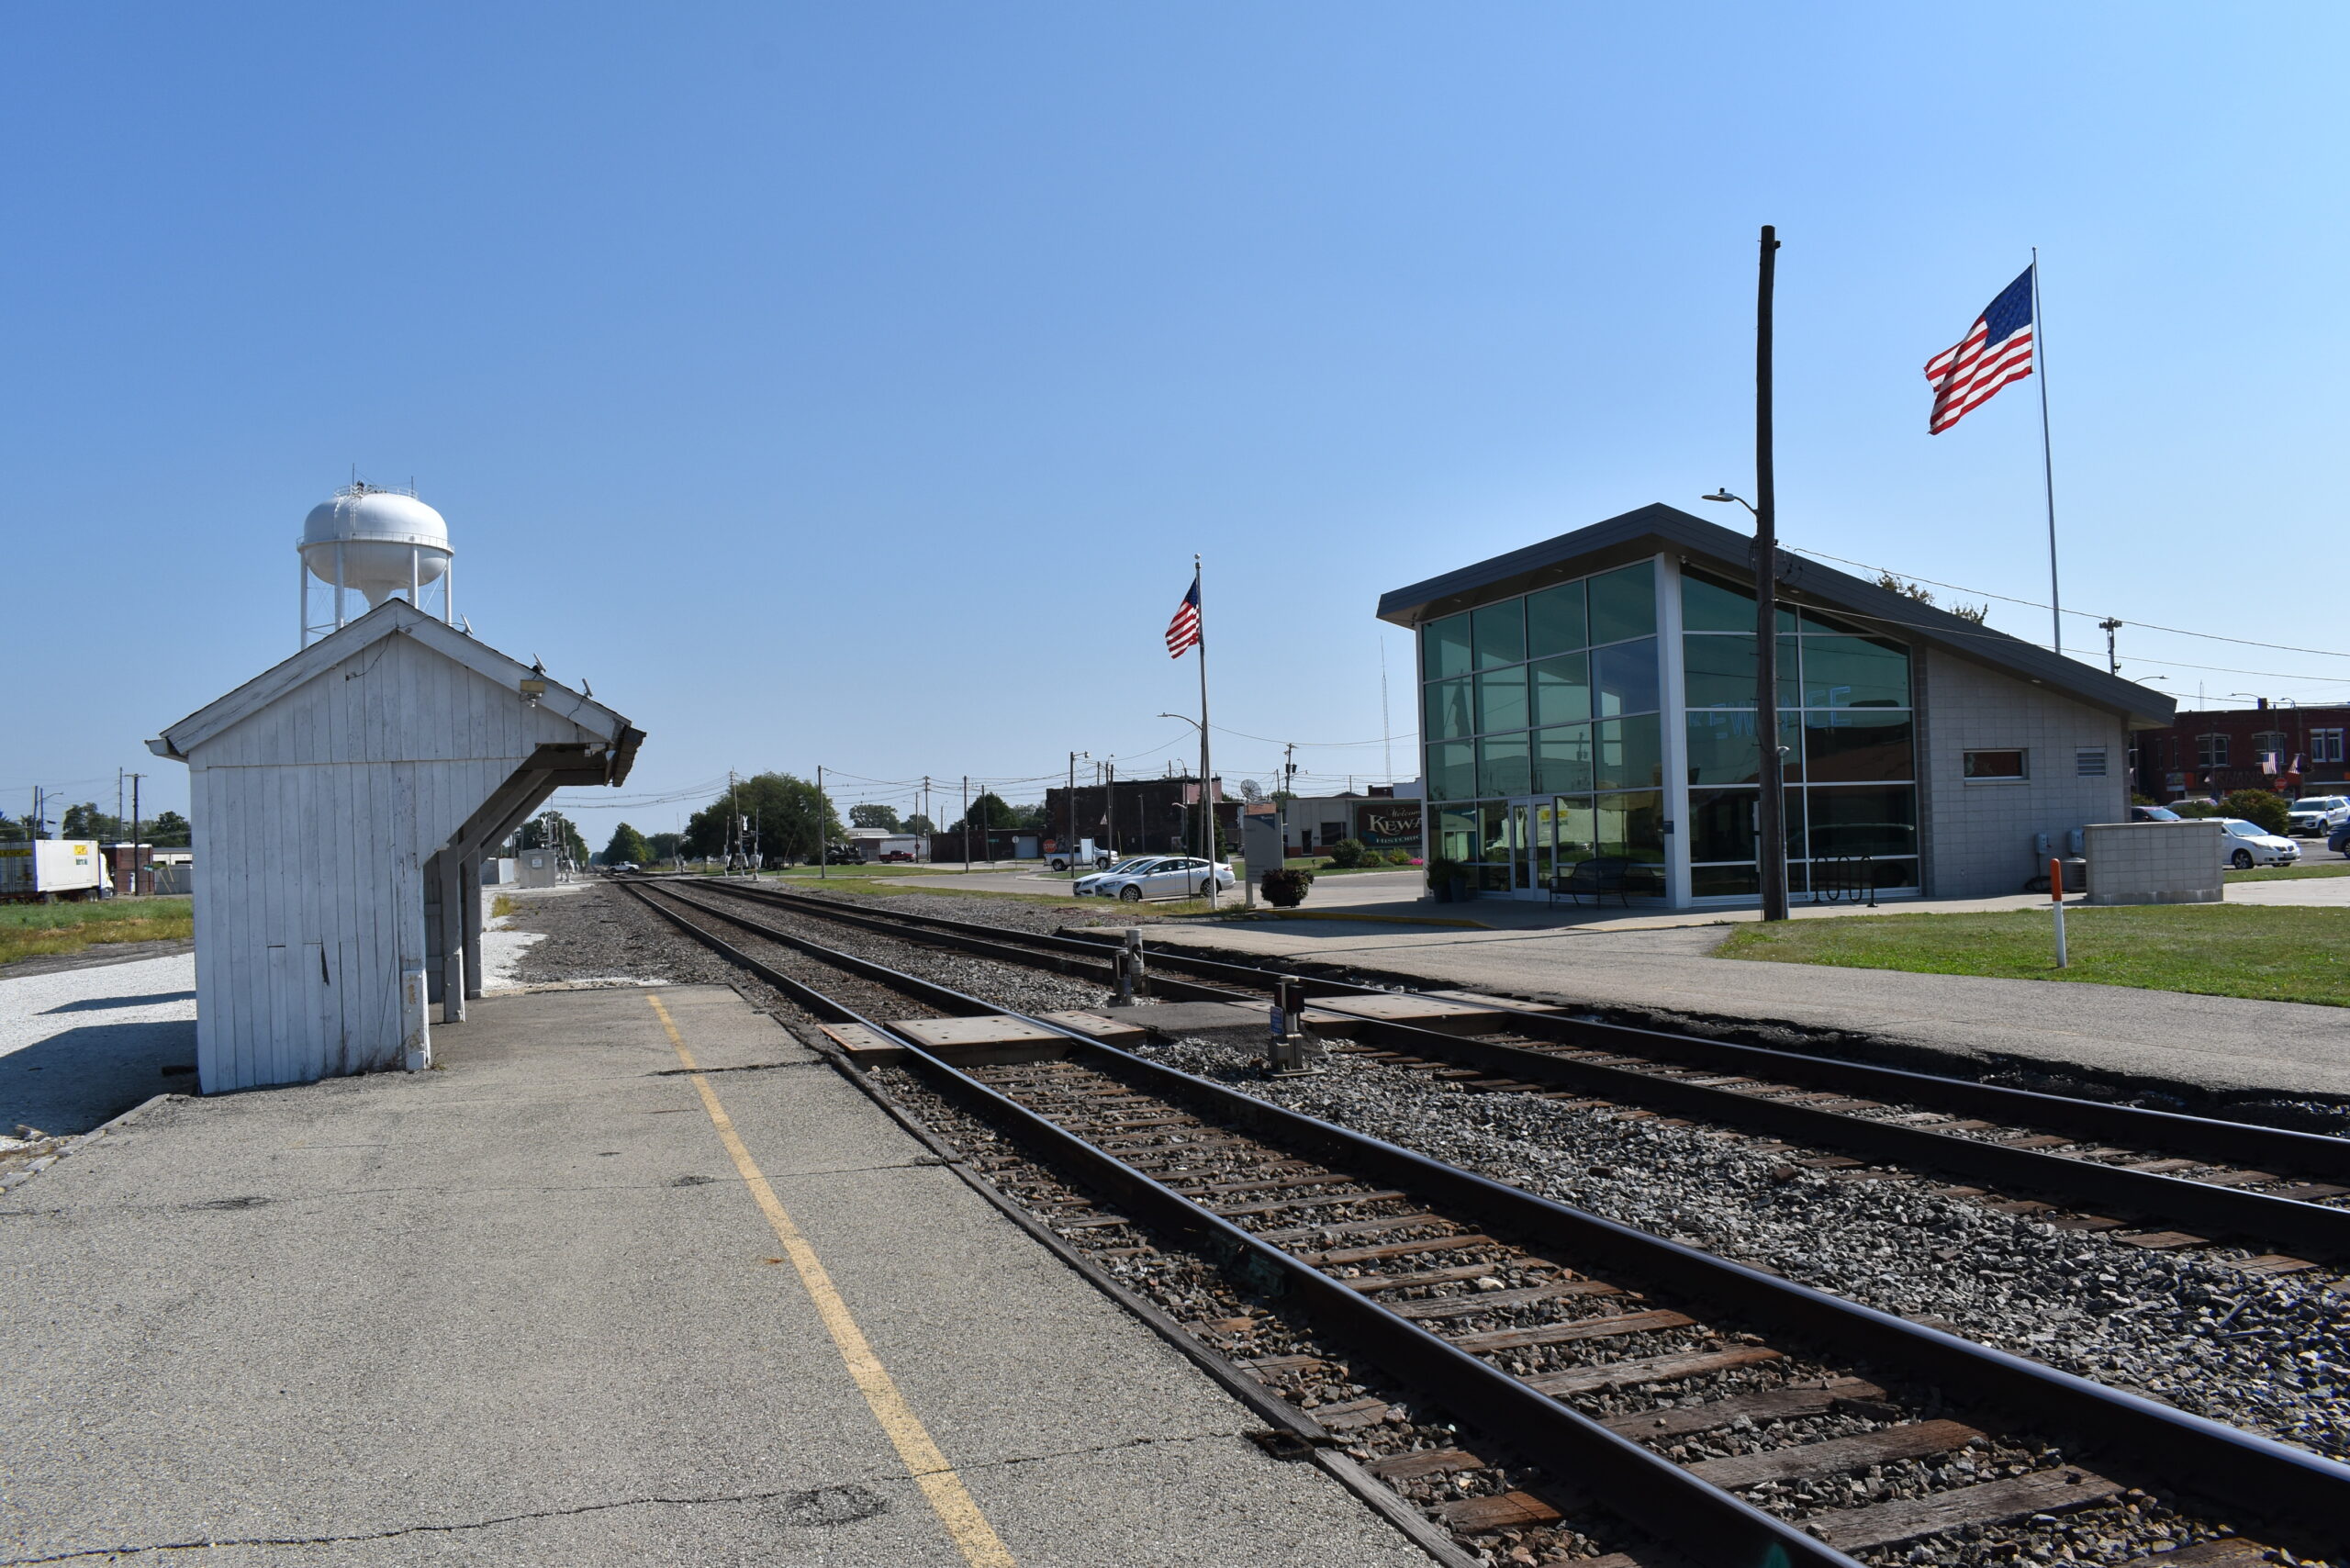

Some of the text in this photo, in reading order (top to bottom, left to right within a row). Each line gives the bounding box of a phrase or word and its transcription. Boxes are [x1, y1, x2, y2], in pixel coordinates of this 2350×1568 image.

[1688, 686, 1852, 739] KEWNEE
[1387, 806, 1421, 818] Welcom
[1368, 813, 1422, 835] KEWA
